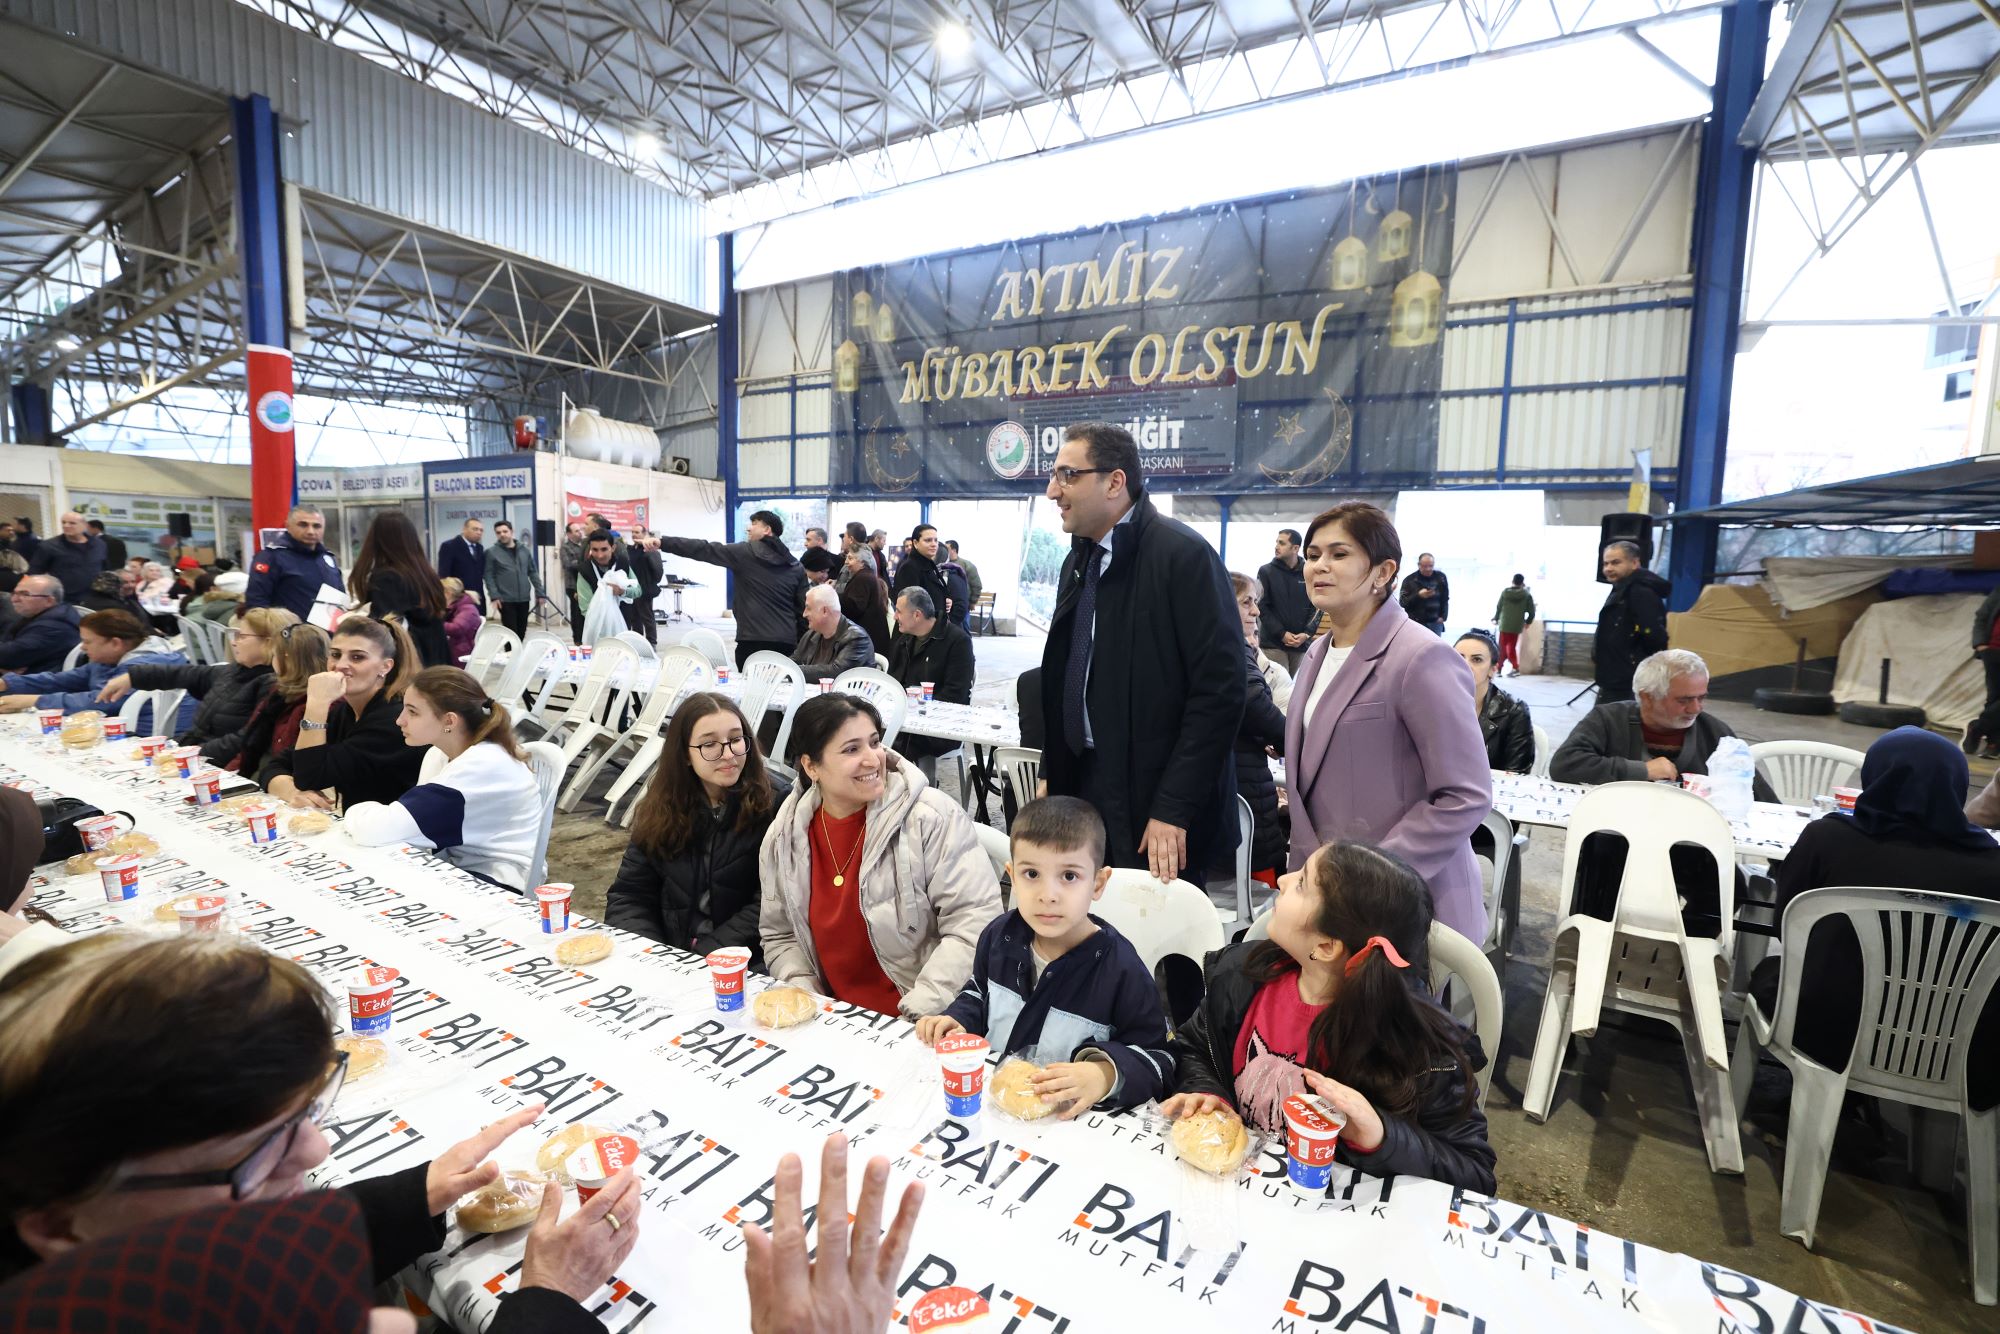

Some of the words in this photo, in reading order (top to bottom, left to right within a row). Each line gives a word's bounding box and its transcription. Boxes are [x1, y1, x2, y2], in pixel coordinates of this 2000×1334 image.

[899, 325, 1128, 404] MÜBAREK
[1129, 302, 1345, 386] OLSUN
[1122, 415, 1185, 450] İĞİT
[297, 479, 332, 492] ÇOVA
[434, 477, 472, 493] BALÇOVA
[474, 471, 526, 490] BELEDİYESİ
[328, 876, 406, 907] BATI
[239, 916, 327, 951] BATI
[437, 928, 527, 962] BATI
[484, 970, 551, 1002] MUTFAK
[502, 956, 599, 995] BATI
[418, 1012, 531, 1070] BATI
[560, 1004, 637, 1041] MUTFAK
[395, 1036, 447, 1064] MUTF
[651, 1045, 742, 1090] MUTFAK
[668, 1018, 787, 1078] BATI
[477, 1085, 561, 1139] MUTAK
[499, 1055, 625, 1125] BATI
[319, 1109, 426, 1175] ATI
[908, 1118, 1061, 1204] BATI
[1073, 1114, 1181, 1162] UTFA
[890, 1155, 1022, 1220] MUTFAK
[1057, 1227, 1220, 1306] MUTFAK
[1442, 1229, 1641, 1313] MUTFAK
